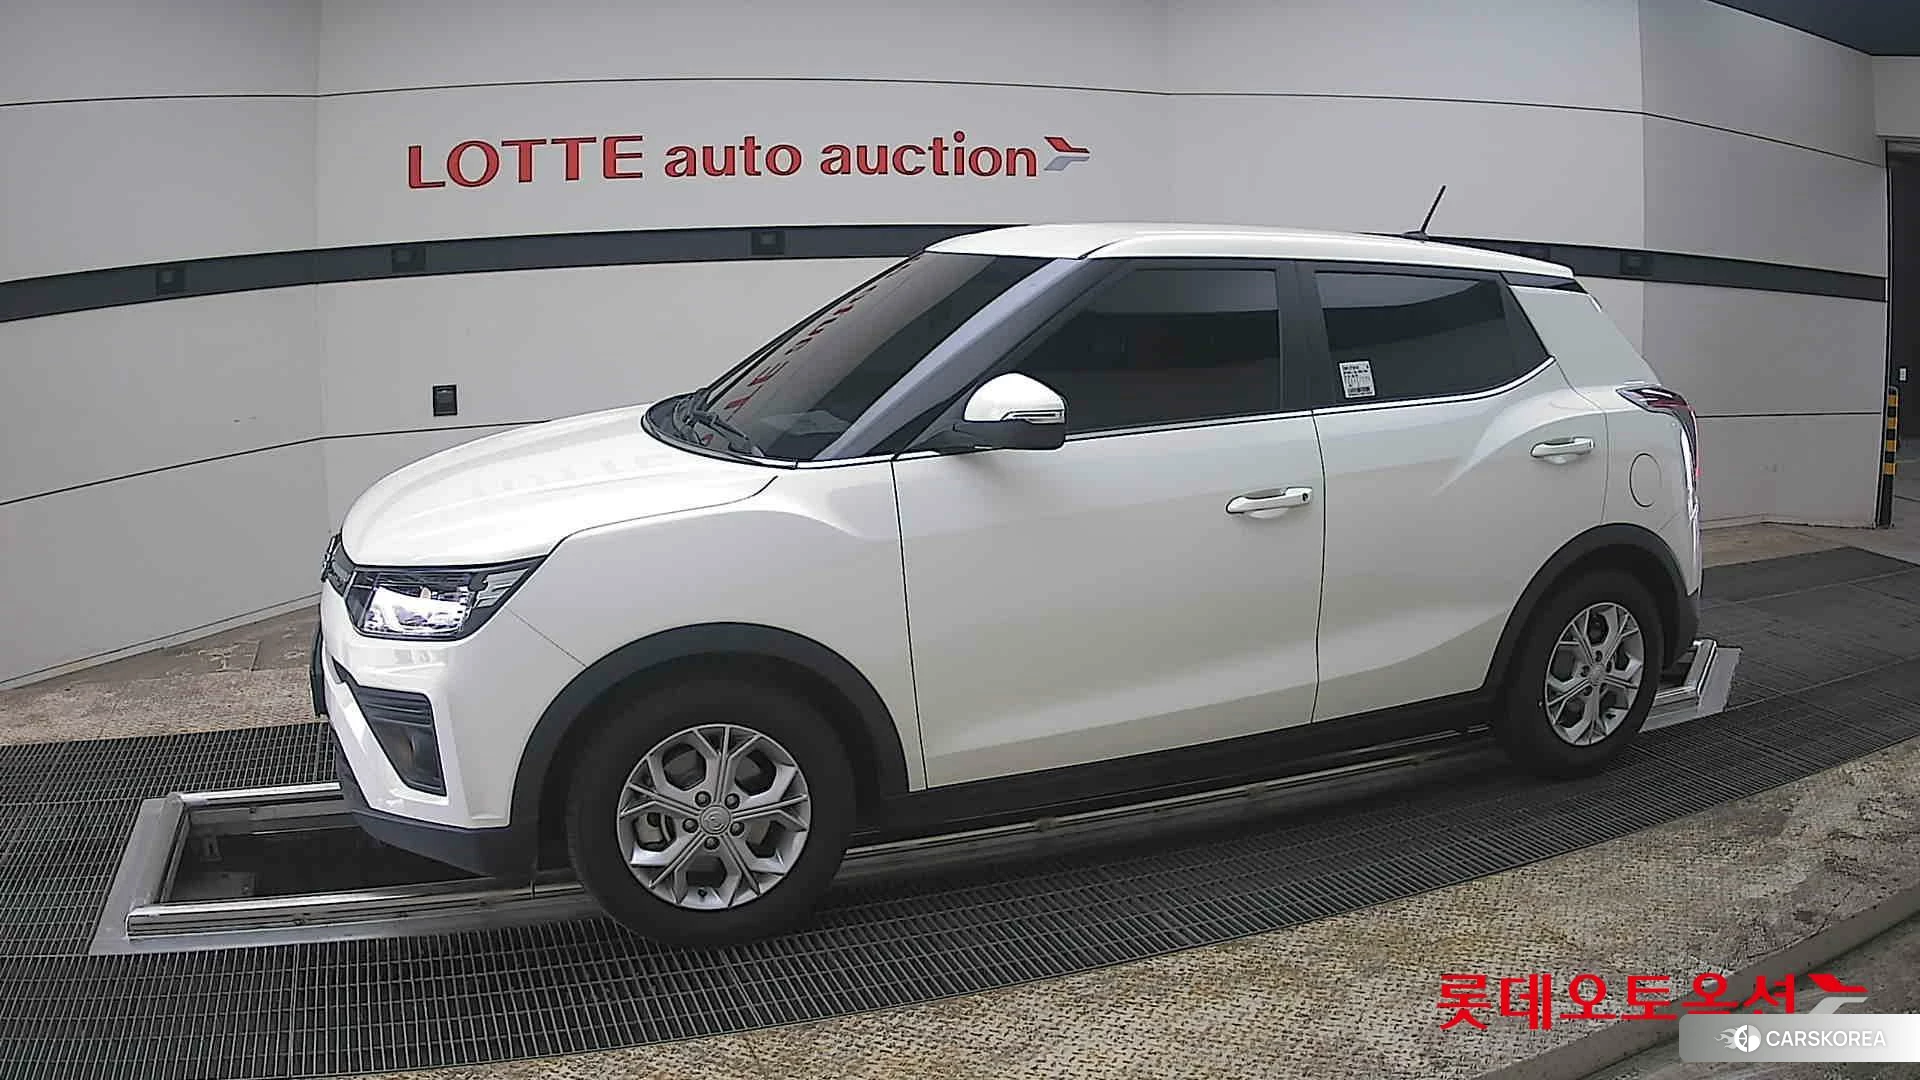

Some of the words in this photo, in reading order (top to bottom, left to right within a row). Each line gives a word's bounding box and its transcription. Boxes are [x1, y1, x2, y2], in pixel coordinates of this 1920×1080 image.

[408, 135, 644, 189] LOTTE
[664, 136, 801, 177] auto
[820, 131, 1038, 177] auction
